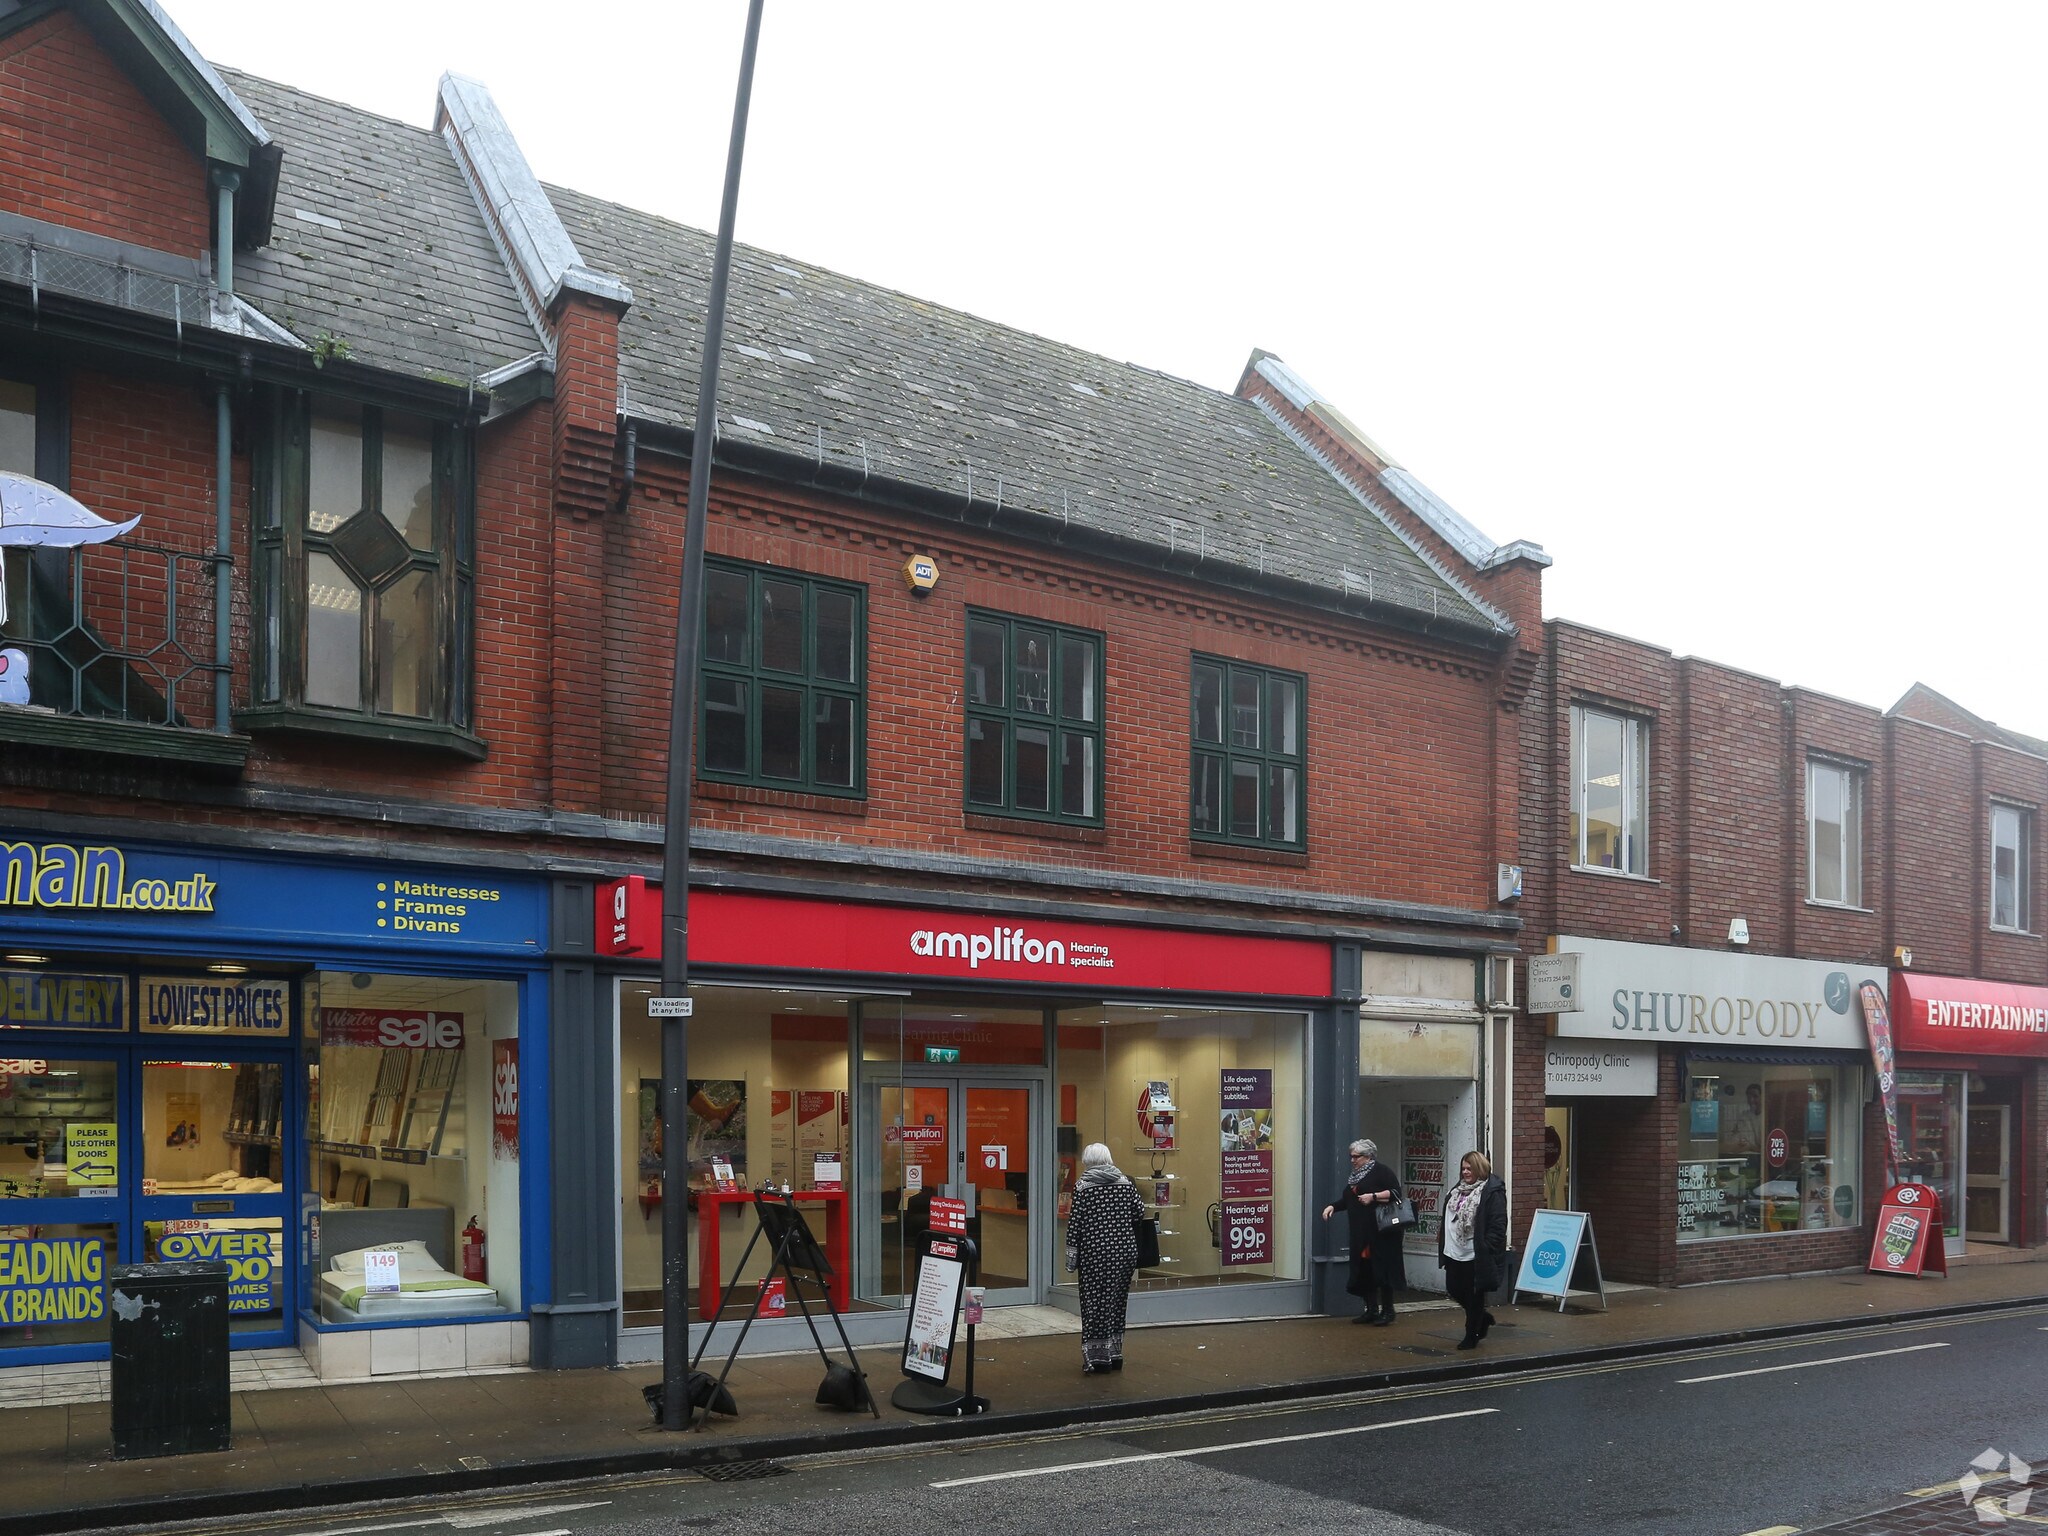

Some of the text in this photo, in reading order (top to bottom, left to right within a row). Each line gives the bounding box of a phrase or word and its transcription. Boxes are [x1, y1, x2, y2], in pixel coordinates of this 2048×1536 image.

[915, 566, 932, 577] ADT
[394, 880, 500, 901] Mattresses
[394, 898, 467, 917] Frames
[394, 916, 460, 934] Divans
[910, 926, 1065, 969] amplifon
[1070, 941, 1109, 957] Hearing
[1070, 956, 1114, 968] specialist
[1532, 958, 1563, 968] Chiropody
[149, 984, 282, 1029] LOWEST PRICES
[1530, 1000, 1573, 1010] SHUROPODY
[1612, 988, 1823, 1039] SHUROPODY
[1928, 999, 2048, 1033] ENTERTAINME
[378, 1012, 462, 1048] sale
[952, 1027, 993, 1043] Clinic
[1548, 1052, 1630, 1070] Chiropody Clinic
[494, 1049, 518, 1116] sale
[1236, 1075, 1257, 1083] doesn't
[1555, 1073, 1576, 1082] 01473
[1577, 1074, 1589, 1082] 254
[1590, 1074, 1602, 1082] 949
[902, 1128, 941, 1140] amplifon
[1771, 1138, 1785, 1148] 70%
[1771, 1149, 1785, 1158] OFF
[1417, 1170, 1442, 1182] TABLES
[1710, 1177, 1717, 1188] &
[1678, 1189, 1725, 1202] WELL BEING
[1226, 1204, 1269, 1215] Hearing aid
[1678, 1202, 1718, 1215] FOR YOUR
[180, 1220, 200, 1229] 289
[1231, 1216, 1265, 1225] batteries
[1678, 1216, 1695, 1228] FEET
[1904, 1217, 1916, 1227] BUY
[1887, 1224, 1914, 1238] PHONES
[1229, 1226, 1266, 1249] 99p
[1886, 1235, 1908, 1251] CASH
[160, 1234, 269, 1259] OVER
[371, 1255, 396, 1267] 149
[1231, 1250, 1264, 1262] per pack
[1538, 1251, 1561, 1260] FOOT
[1537, 1258, 1559, 1267] CLINIC
[13, 1286, 102, 1323] BRANDS
